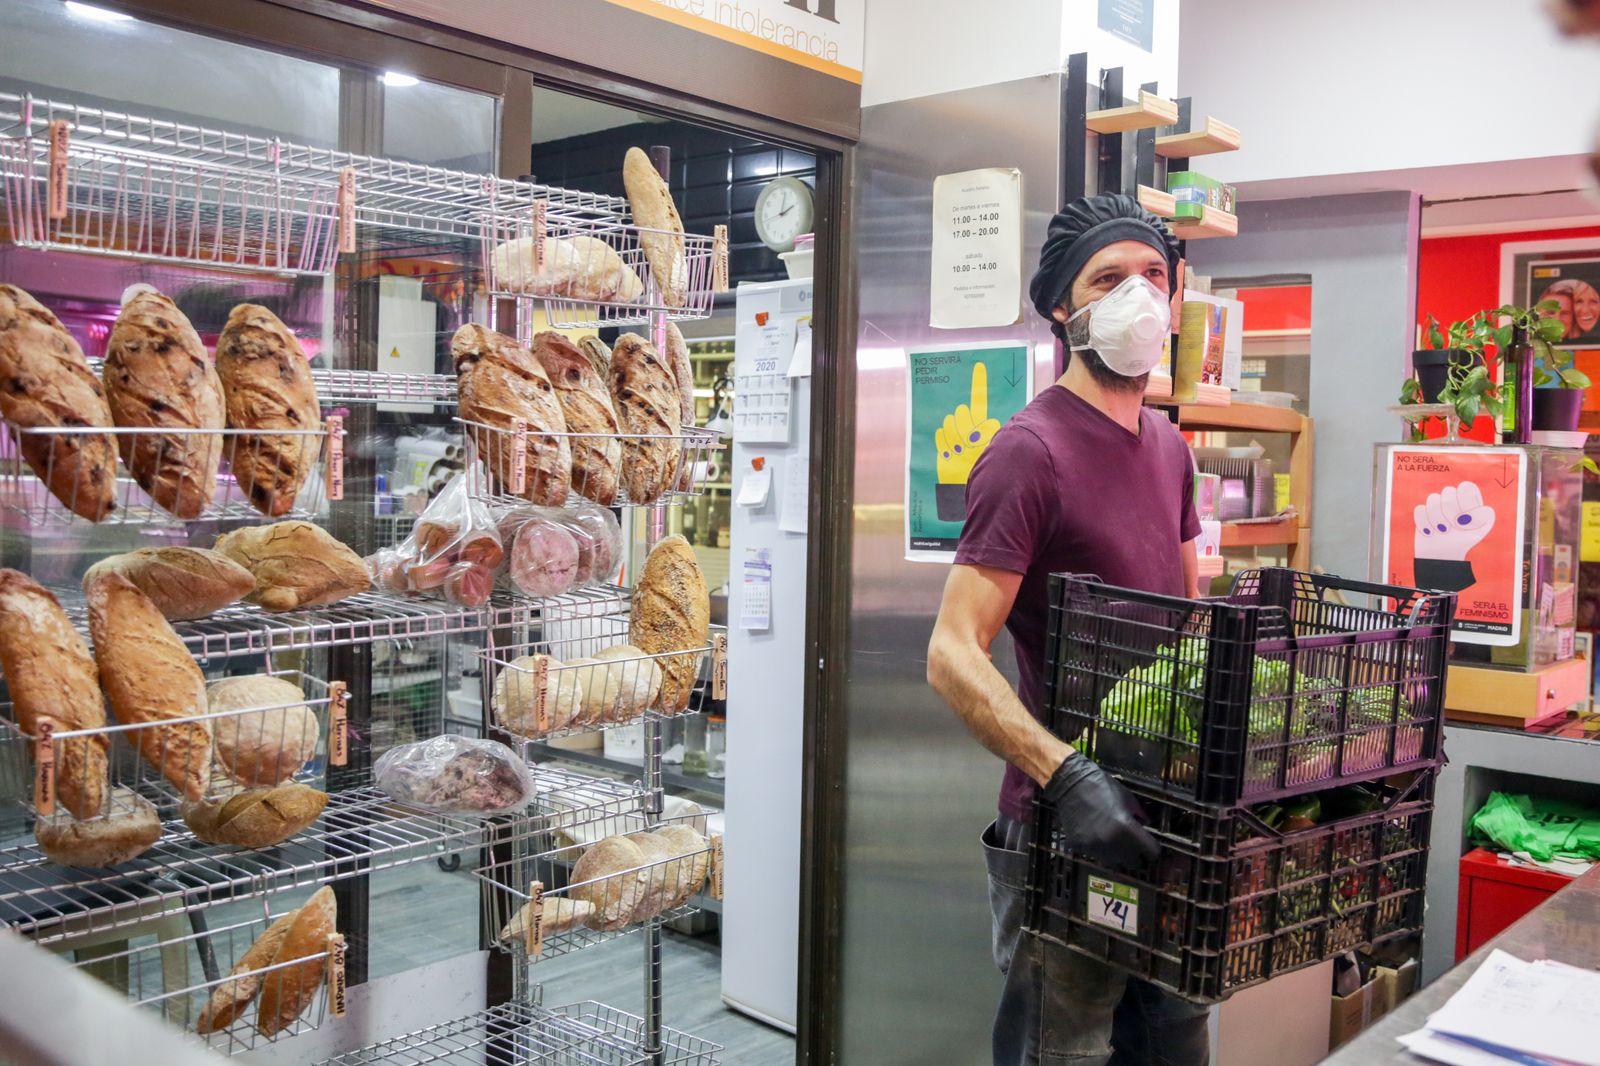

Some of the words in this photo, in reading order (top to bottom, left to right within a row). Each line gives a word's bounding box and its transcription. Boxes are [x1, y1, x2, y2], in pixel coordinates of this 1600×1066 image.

[714, 0, 840, 63] intolerancia
[952, 215, 971, 224] 11.00
[979, 212, 999, 222] 14.00
[952, 229, 971, 239] 17.00
[978, 226, 999, 236] 20.00
[952, 264, 971, 273] 10.00
[978, 262, 997, 271] 14.00
[755, 361, 776, 372] 2020
[915, 358, 928, 366] NO
[915, 367, 938, 375] PEDIR
[915, 376, 950, 384] PERMISO
[1417, 464, 1450, 472] FUERZA
[1498, 603, 1509, 611] EL
[1459, 608, 1509, 619] FEMINISMO
